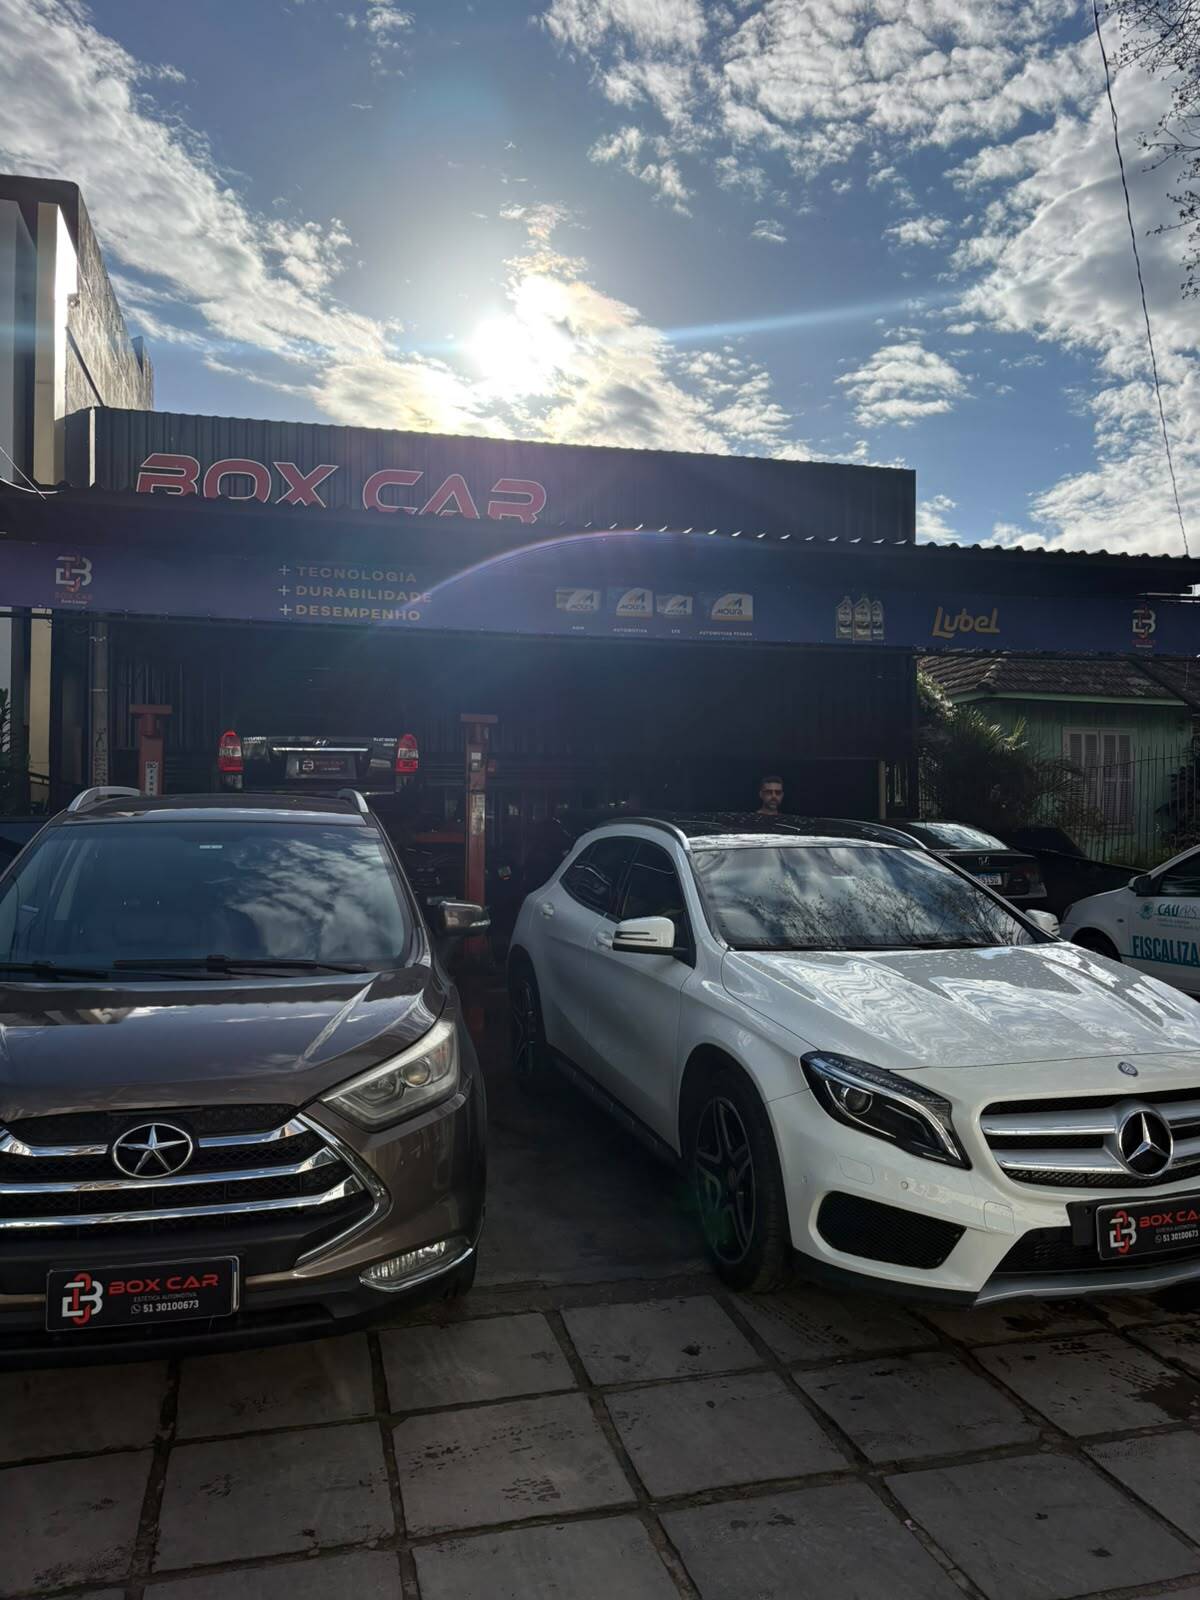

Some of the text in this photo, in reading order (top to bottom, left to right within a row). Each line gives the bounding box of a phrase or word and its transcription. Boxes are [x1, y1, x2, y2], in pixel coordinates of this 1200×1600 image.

[136, 452, 547, 524] BOX CAR
[295, 566, 417, 583] TECNOLOGIA
[295, 585, 433, 603] DURABILIDADE
[295, 604, 421, 621] DESEMPENHO
[931, 606, 1000, 640] Lubel
[1139, 1212, 1173, 1228] BOX
[1176, 1209, 1200, 1222] CA
[1162, 1233, 1171, 1243] 51
[107, 1278, 161, 1296] BOX
[165, 1273, 220, 1291] CAR
[143, 1299, 199, 1313] 51 30100673
